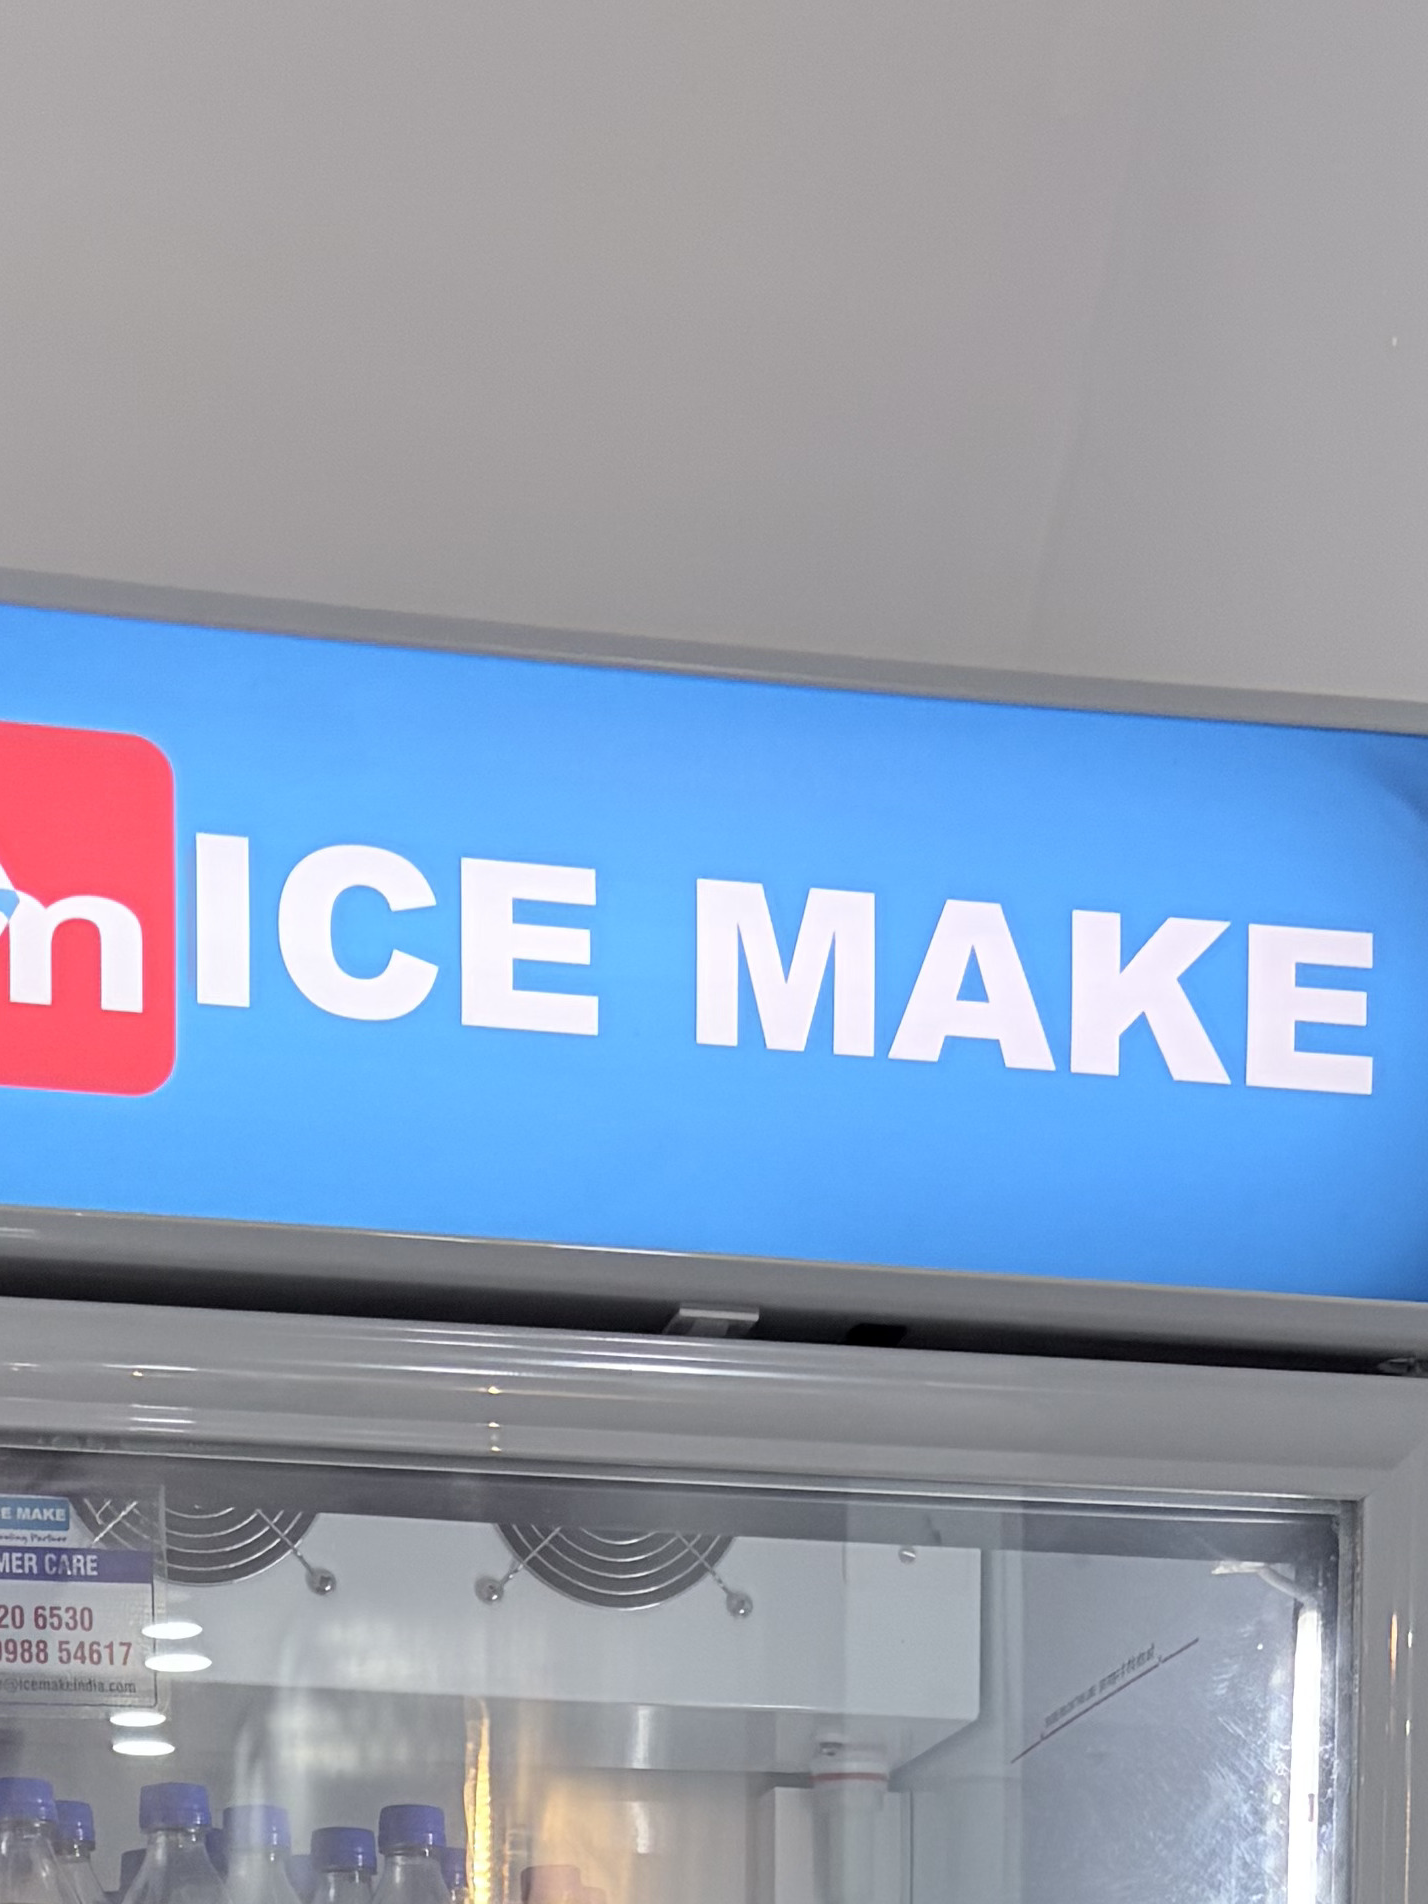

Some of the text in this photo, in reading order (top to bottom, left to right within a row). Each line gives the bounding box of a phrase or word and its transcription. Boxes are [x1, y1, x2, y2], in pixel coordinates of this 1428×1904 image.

[195, 831, 600, 1037] ICE
[694, 876, 1376, 1096] MAKE
[16, 1507, 67, 1522] MAKE
[44, 1551, 99, 1577] CARE
[33, 1605, 94, 1632] 6530
[58, 1640, 132, 1666] 54617
